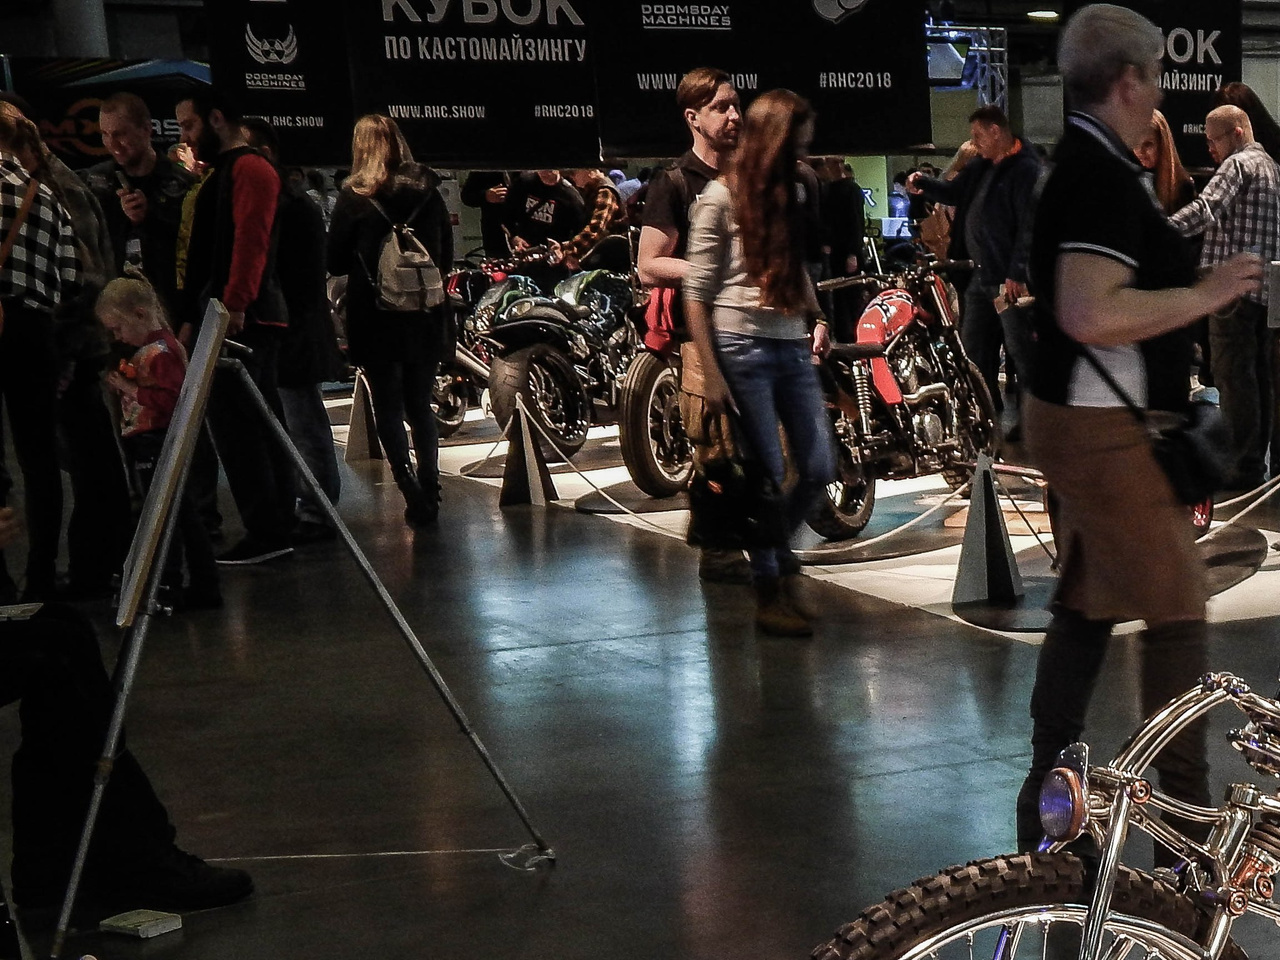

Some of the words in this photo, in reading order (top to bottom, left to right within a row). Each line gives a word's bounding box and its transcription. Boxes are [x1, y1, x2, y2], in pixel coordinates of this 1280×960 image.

[641, 4, 730, 15] DOOMSDAY
[642, 15, 731, 26] MACHINES
[384, 36, 411, 59] ПО
[417, 33, 587, 62] КАСТОМАЙЗИНГУ
[819, 72, 892, 88] #RHC2018
[388, 105, 486, 119] WWW.RHC.SHOW
[534, 105, 594, 118] #RHC2018
